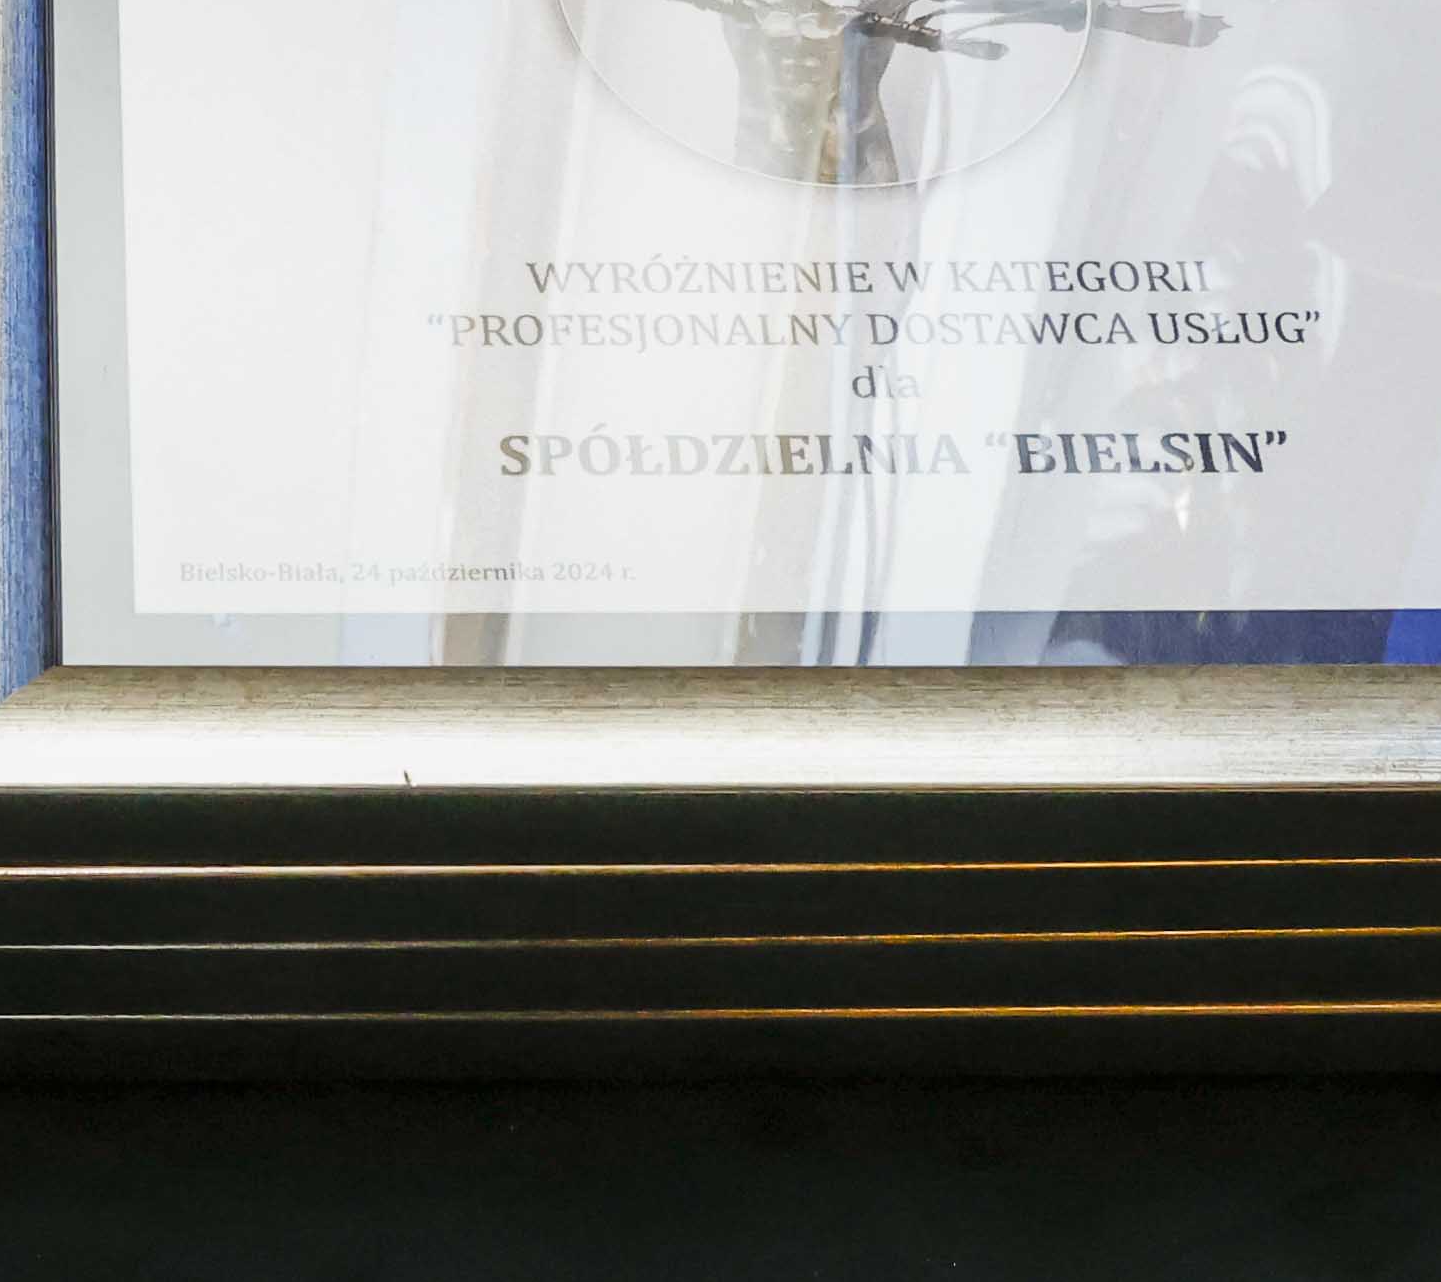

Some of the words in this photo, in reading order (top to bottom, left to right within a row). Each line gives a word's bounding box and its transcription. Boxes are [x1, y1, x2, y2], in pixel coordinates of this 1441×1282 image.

[524, 259, 875, 295] WYRÓŻNIENIE
[882, 260, 931, 294] W
[951, 260, 1209, 294] KATEGORII
[865, 312, 1138, 346] DOSTAWCA
[500, 432, 970, 477] SPÓŁDZIELNIA
[179, 561, 346, 585] Bielsko-Biała,
[349, 562, 383, 582] 24
[390, 561, 545, 586] października
[550, 561, 614, 582] 2024
